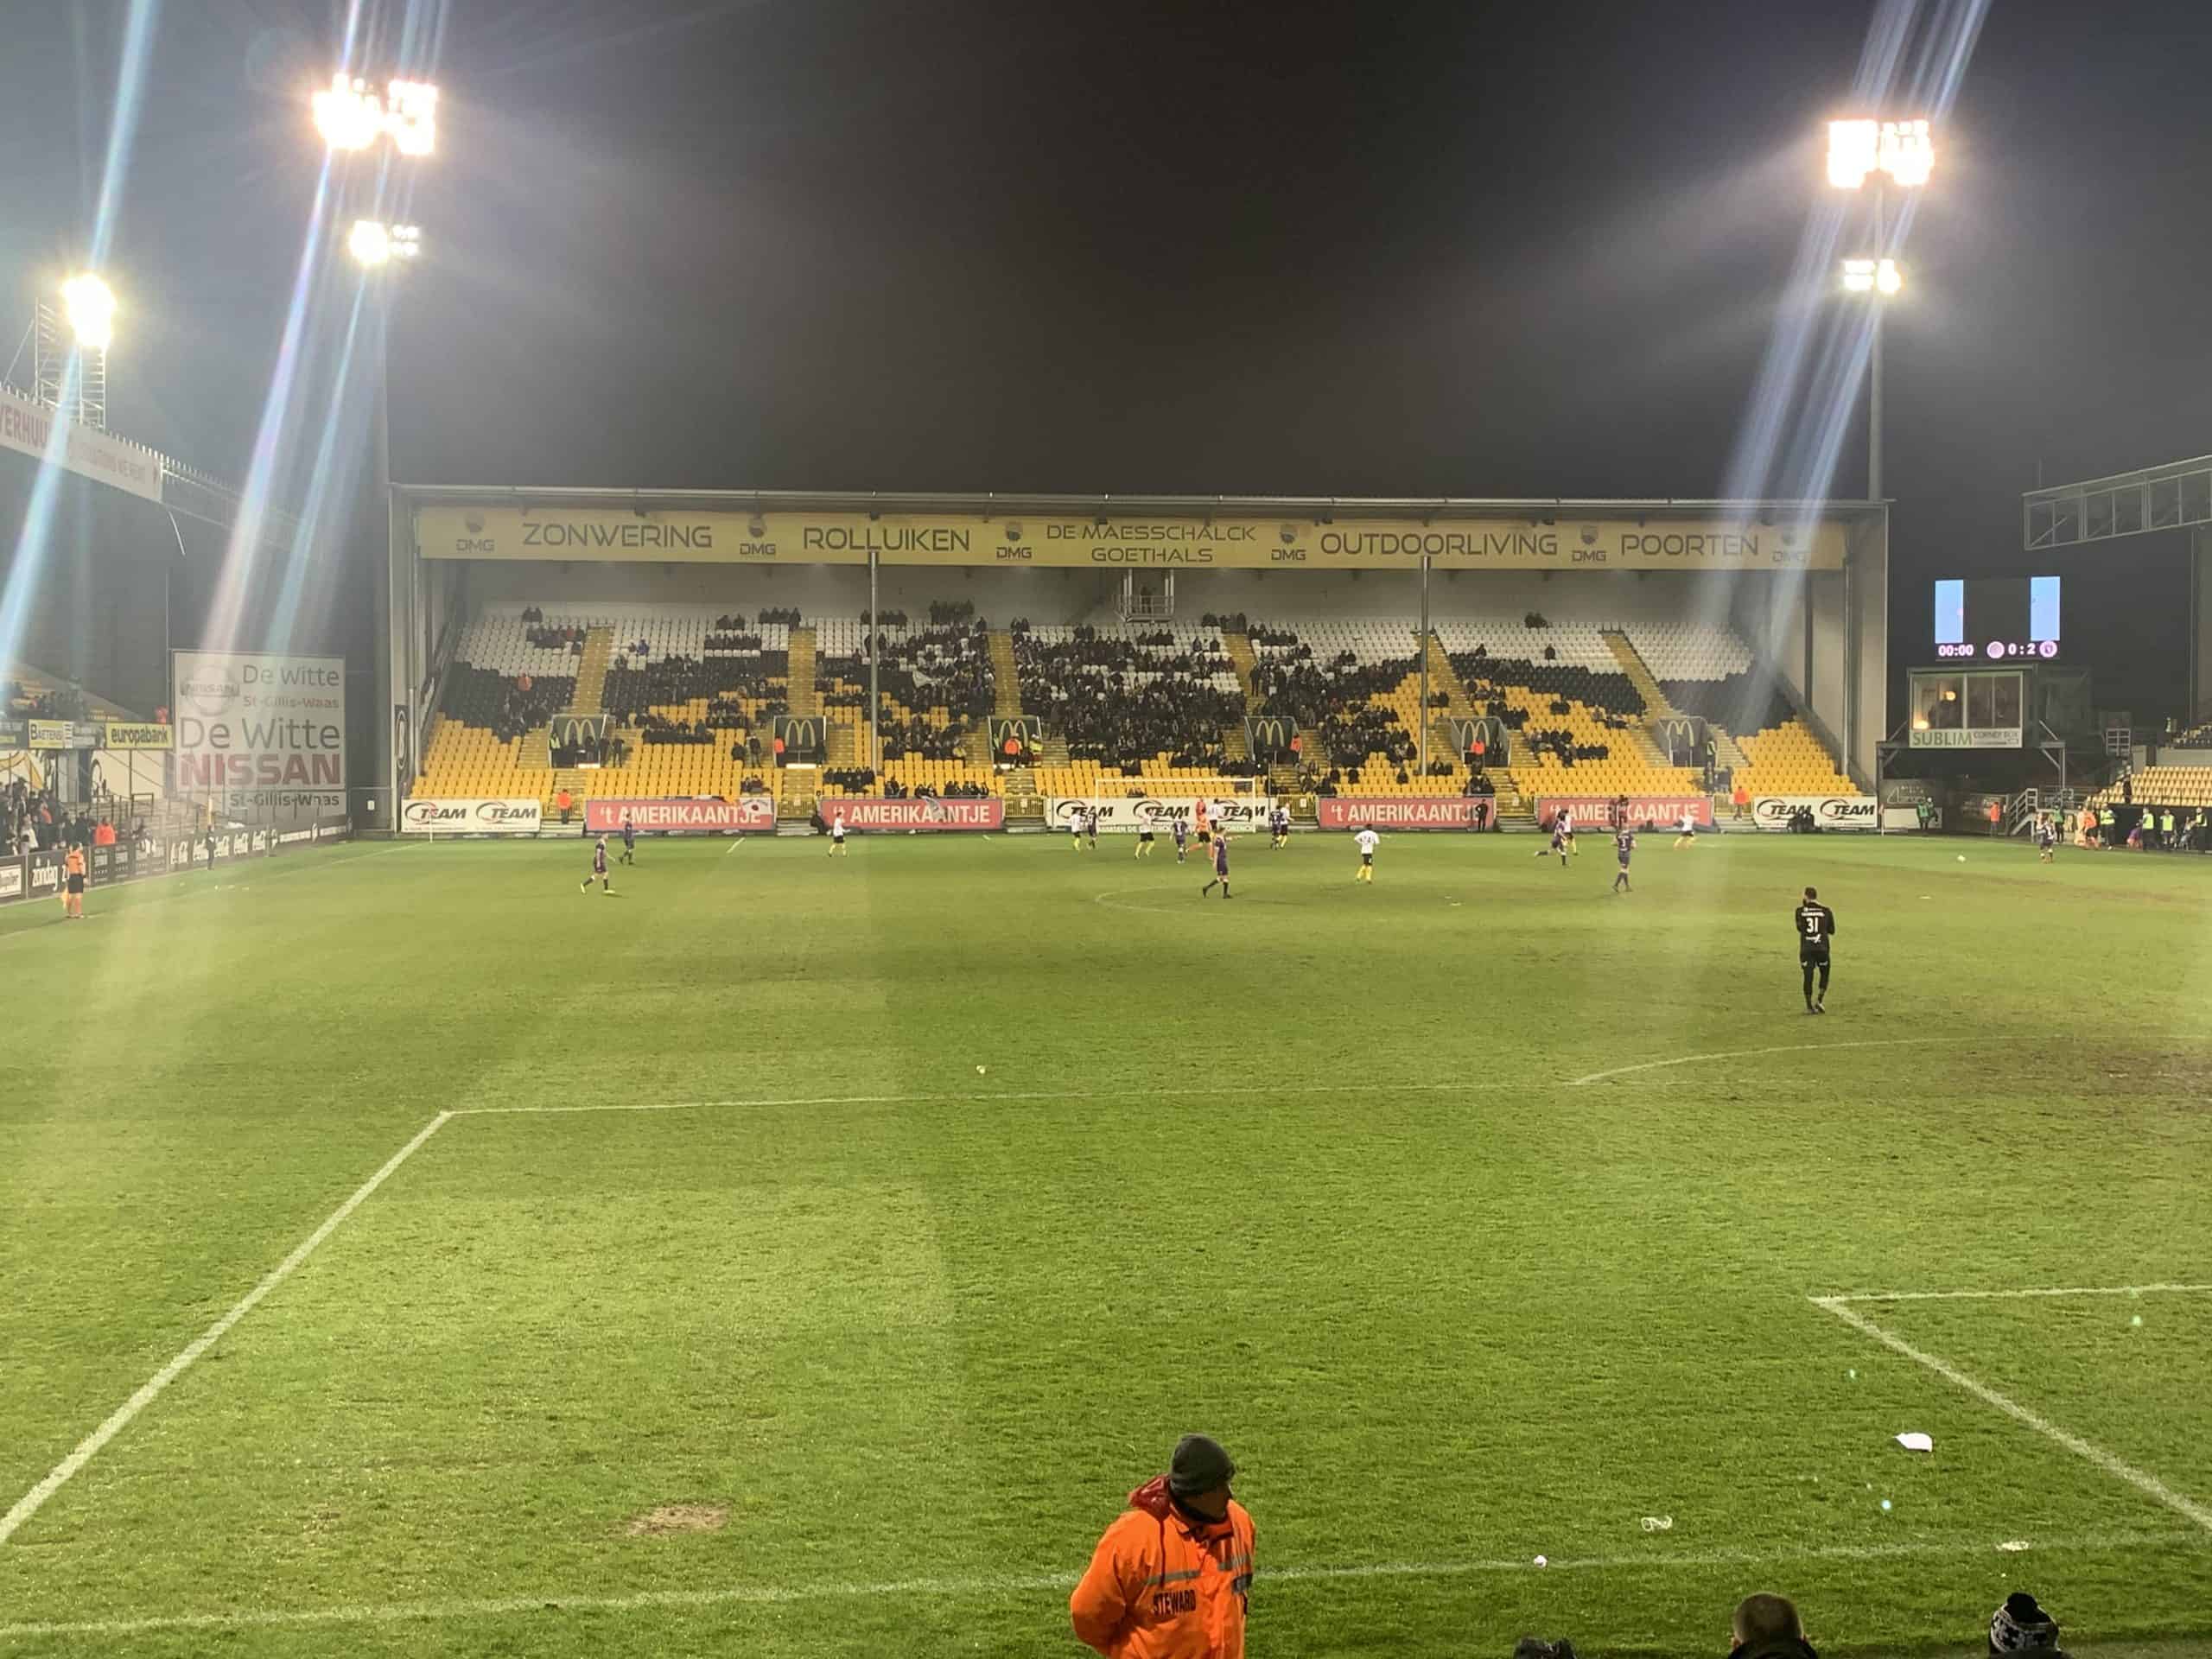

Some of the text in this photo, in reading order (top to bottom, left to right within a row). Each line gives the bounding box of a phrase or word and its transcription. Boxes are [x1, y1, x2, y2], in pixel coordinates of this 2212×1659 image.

[522, 523, 713, 549] ZONWERING
[804, 527, 969, 551] ROLLUIKEN
[1046, 524, 1256, 541] DE MAESSCHALCK
[456, 538, 495, 552] DMG
[740, 543, 776, 555] DMG
[1320, 532, 1558, 556] OUTDOORLIVING
[1621, 534, 1758, 556] POORTEN
[995, 546, 1033, 559] DMG
[1091, 547, 1213, 563] GOETHALS
[1271, 549, 1306, 561] DMG
[1571, 550, 1606, 563] DMG
[1938, 644, 1974, 657] 00:00
[242, 664, 340, 687] De Witte
[111, 726, 168, 747] europabank
[180, 716, 340, 749] De Witte
[1912, 731, 1973, 747] SUBLIM
[180, 753, 341, 786] NISSAN
[420, 808, 467, 819] TEAM
[491, 808, 537, 819] TEAM
[1348, 803, 1481, 823] AMERIKAANTJE
[1771, 804, 1812, 816] TEAM
[1834, 804, 1875, 816] TEAM
[1806, 917, 1819, 933] 31
[1153, 1589, 1197, 1616] STEWARD
